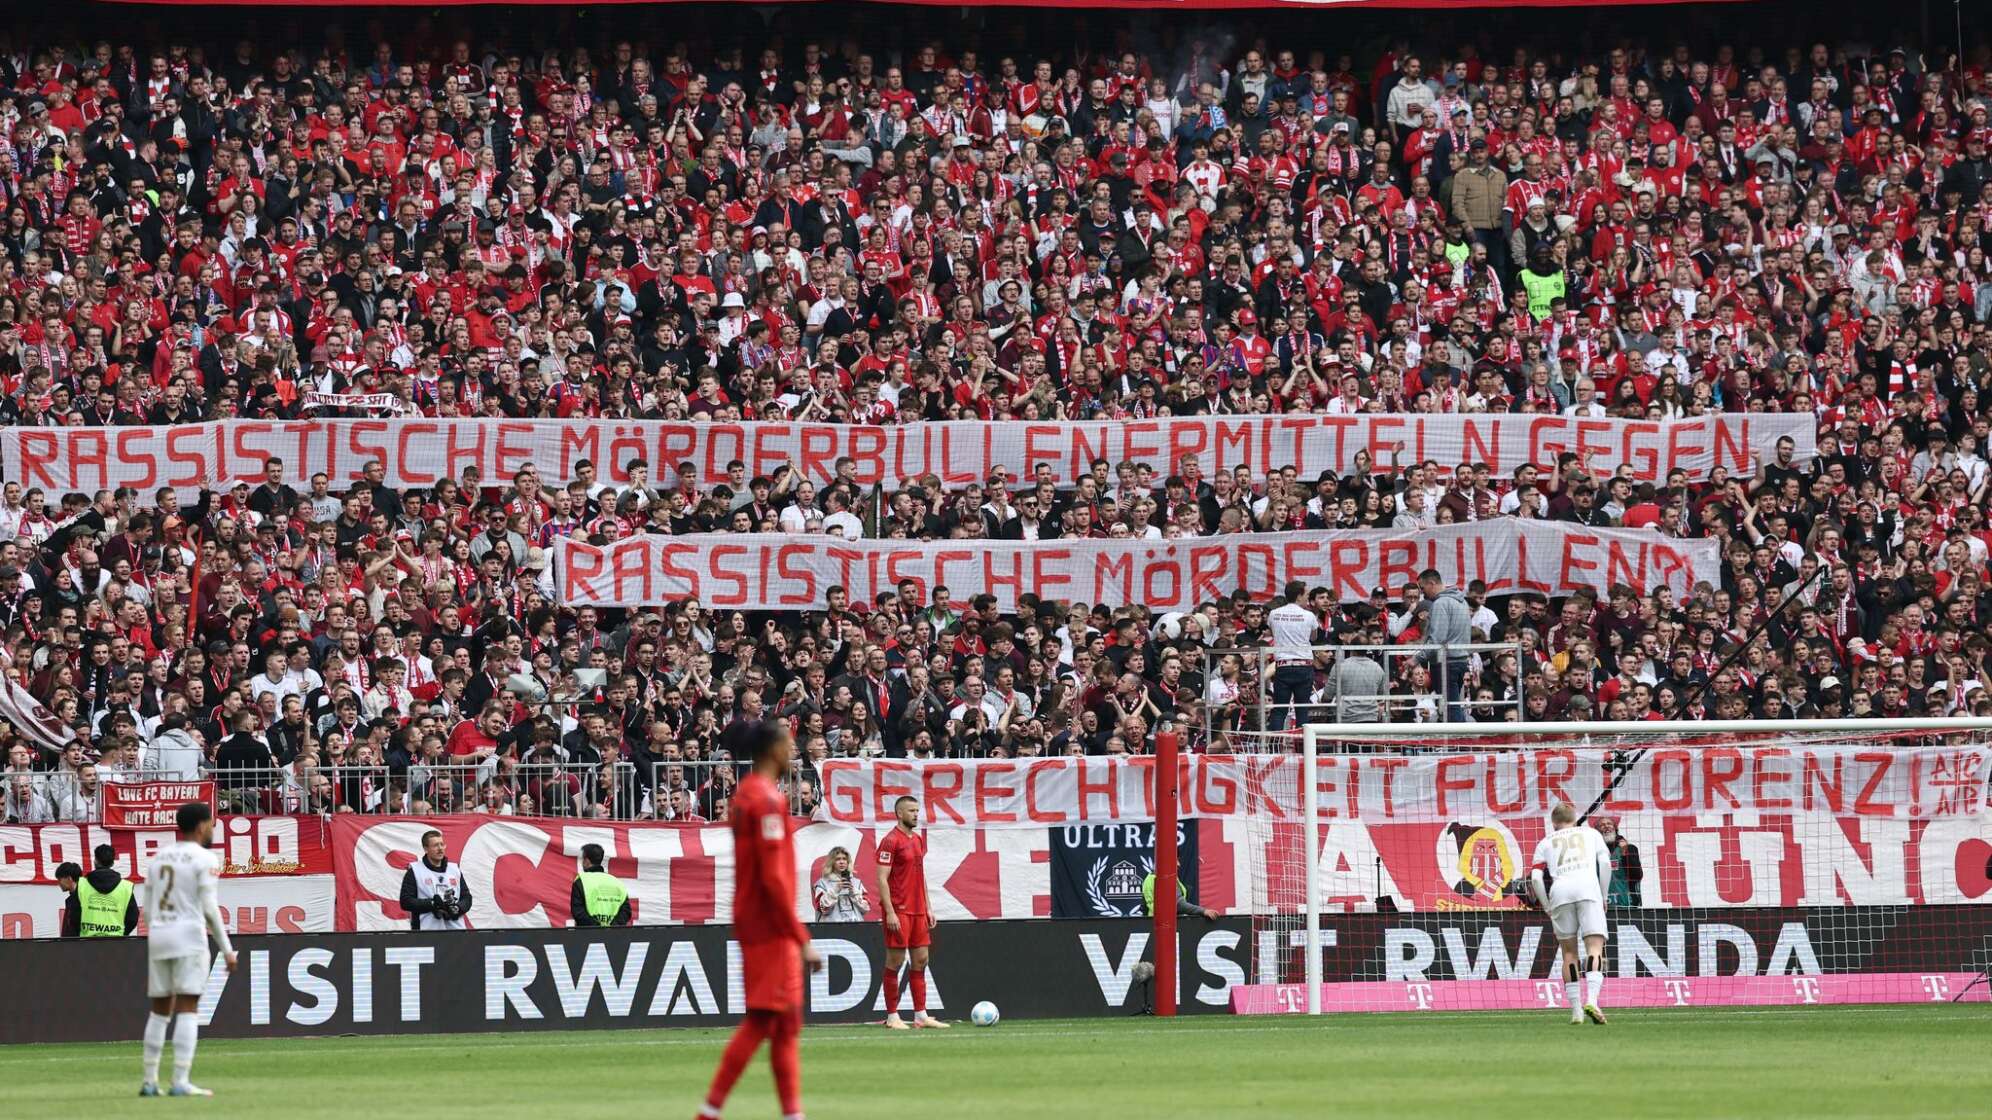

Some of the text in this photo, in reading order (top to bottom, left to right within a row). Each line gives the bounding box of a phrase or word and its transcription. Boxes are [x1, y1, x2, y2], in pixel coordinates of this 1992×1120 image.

[20, 421, 533, 490] RASSISTISCHE
[1529, 417, 1750, 477] GEGEN
[565, 535, 1695, 609] RASSISTISCHE MÖRDERBULLEN?
[118, 785, 200, 801] LOVE FC BAYERN
[124, 810, 178, 825] HATE RACI
[822, 754, 1408, 825] GERECHTIGKEIT
[1551, 832, 1586, 867] 29
[159, 864, 175, 912] 2
[1078, 929, 1337, 1007] VSIT
